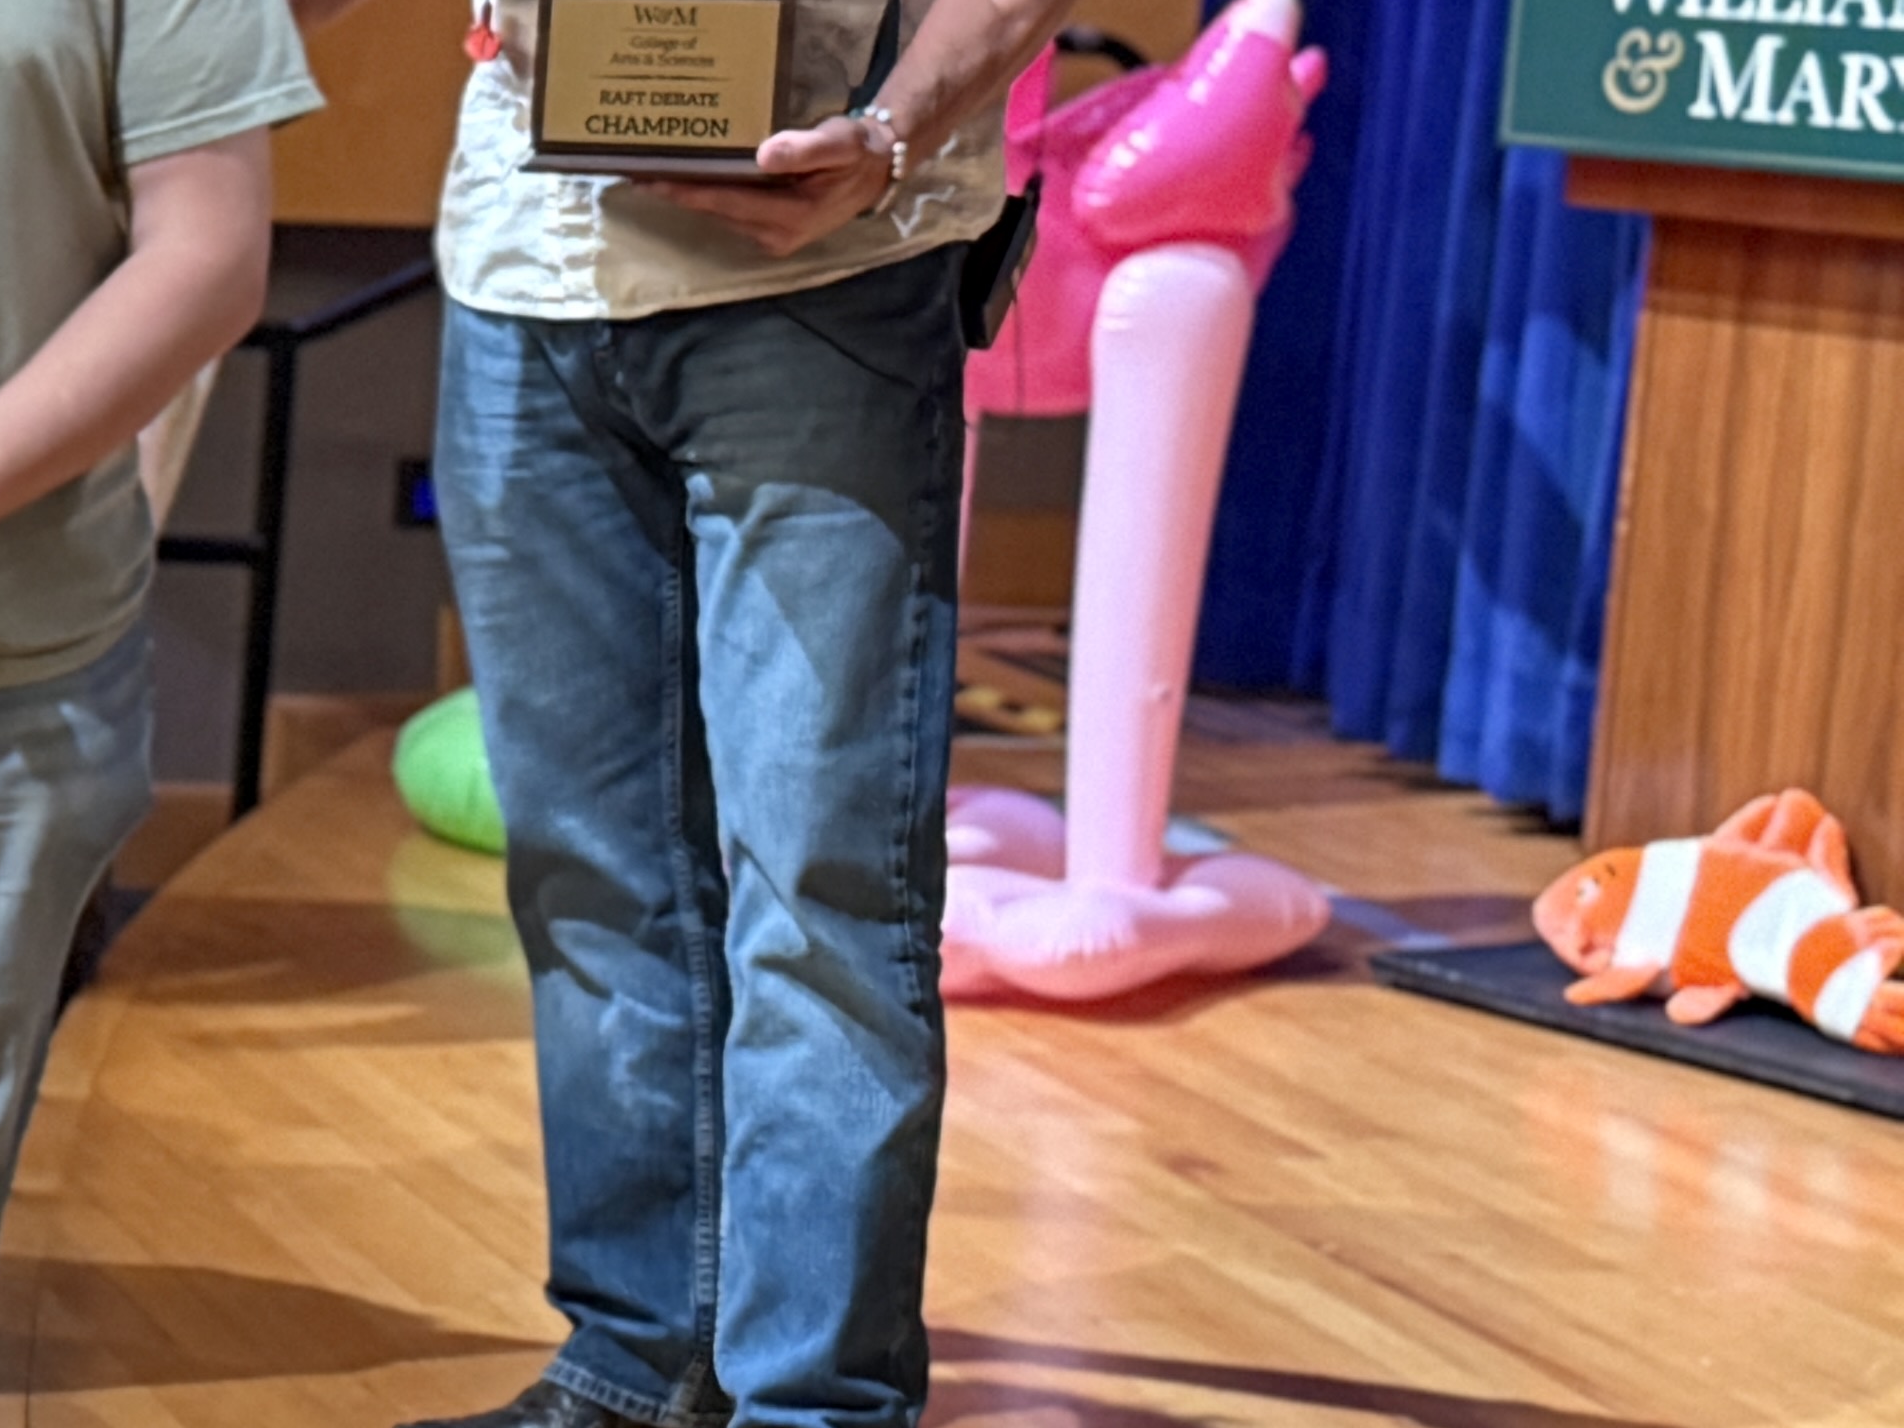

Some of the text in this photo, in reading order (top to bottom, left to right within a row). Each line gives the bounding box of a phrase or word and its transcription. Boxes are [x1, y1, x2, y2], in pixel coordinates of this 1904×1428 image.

[610, 52, 640, 65] Arts
[1601, 26, 1686, 114] &
[600, 90, 720, 106] RAFT DEBATE
[585, 115, 729, 138] CHAMPION
